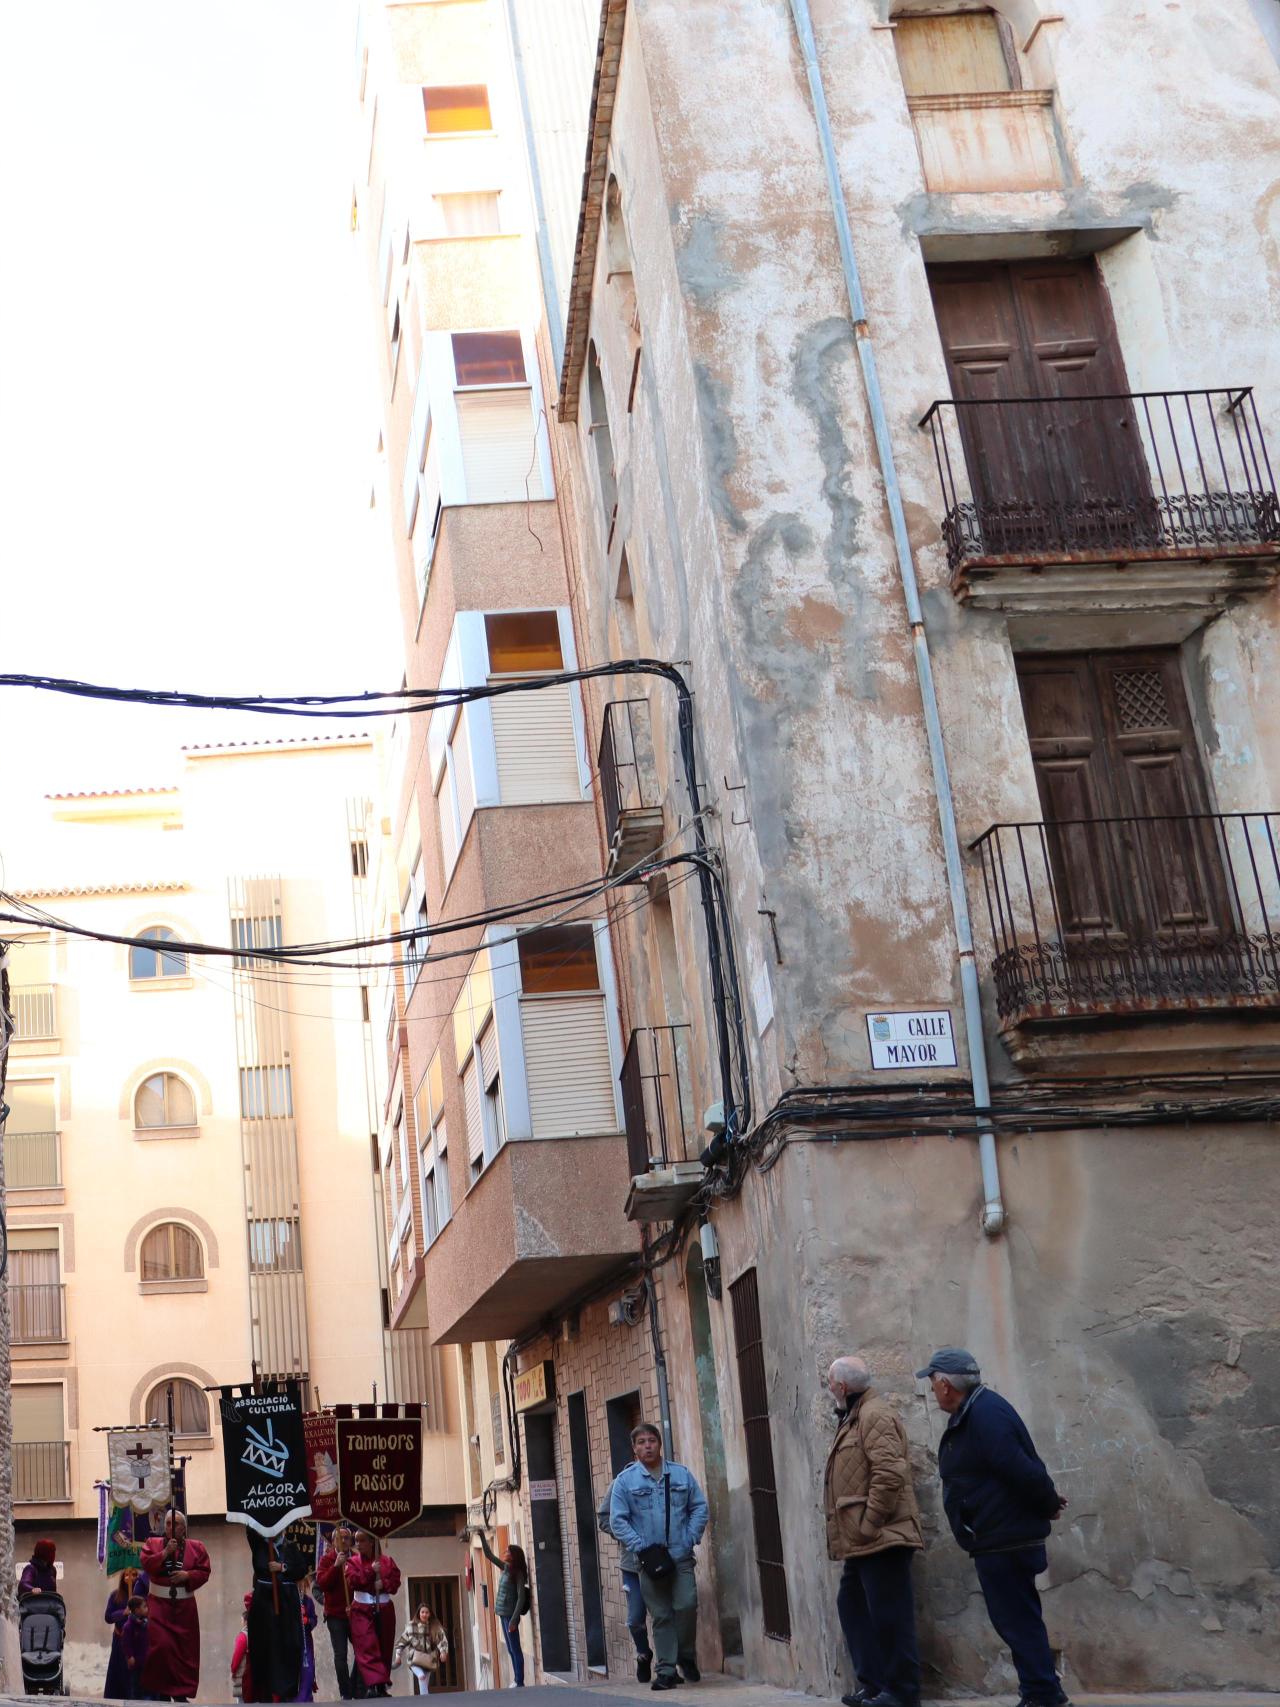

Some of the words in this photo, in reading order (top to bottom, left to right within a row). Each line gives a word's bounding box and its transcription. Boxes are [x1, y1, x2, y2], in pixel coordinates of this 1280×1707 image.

[908, 1018, 946, 1036] CALLE
[887, 1043, 937, 1063] MAYOR
[235, 1394, 288, 1408] ASSOCIACIÓ
[249, 1403, 296, 1414] CULTURAL
[372, 1455, 387, 1470] de
[248, 1482, 306, 1496] ALCORA
[240, 1495, 296, 1510] TAMBOR
[350, 1501, 410, 1513] ALMASSORA
[369, 1517, 392, 1528] 1990
